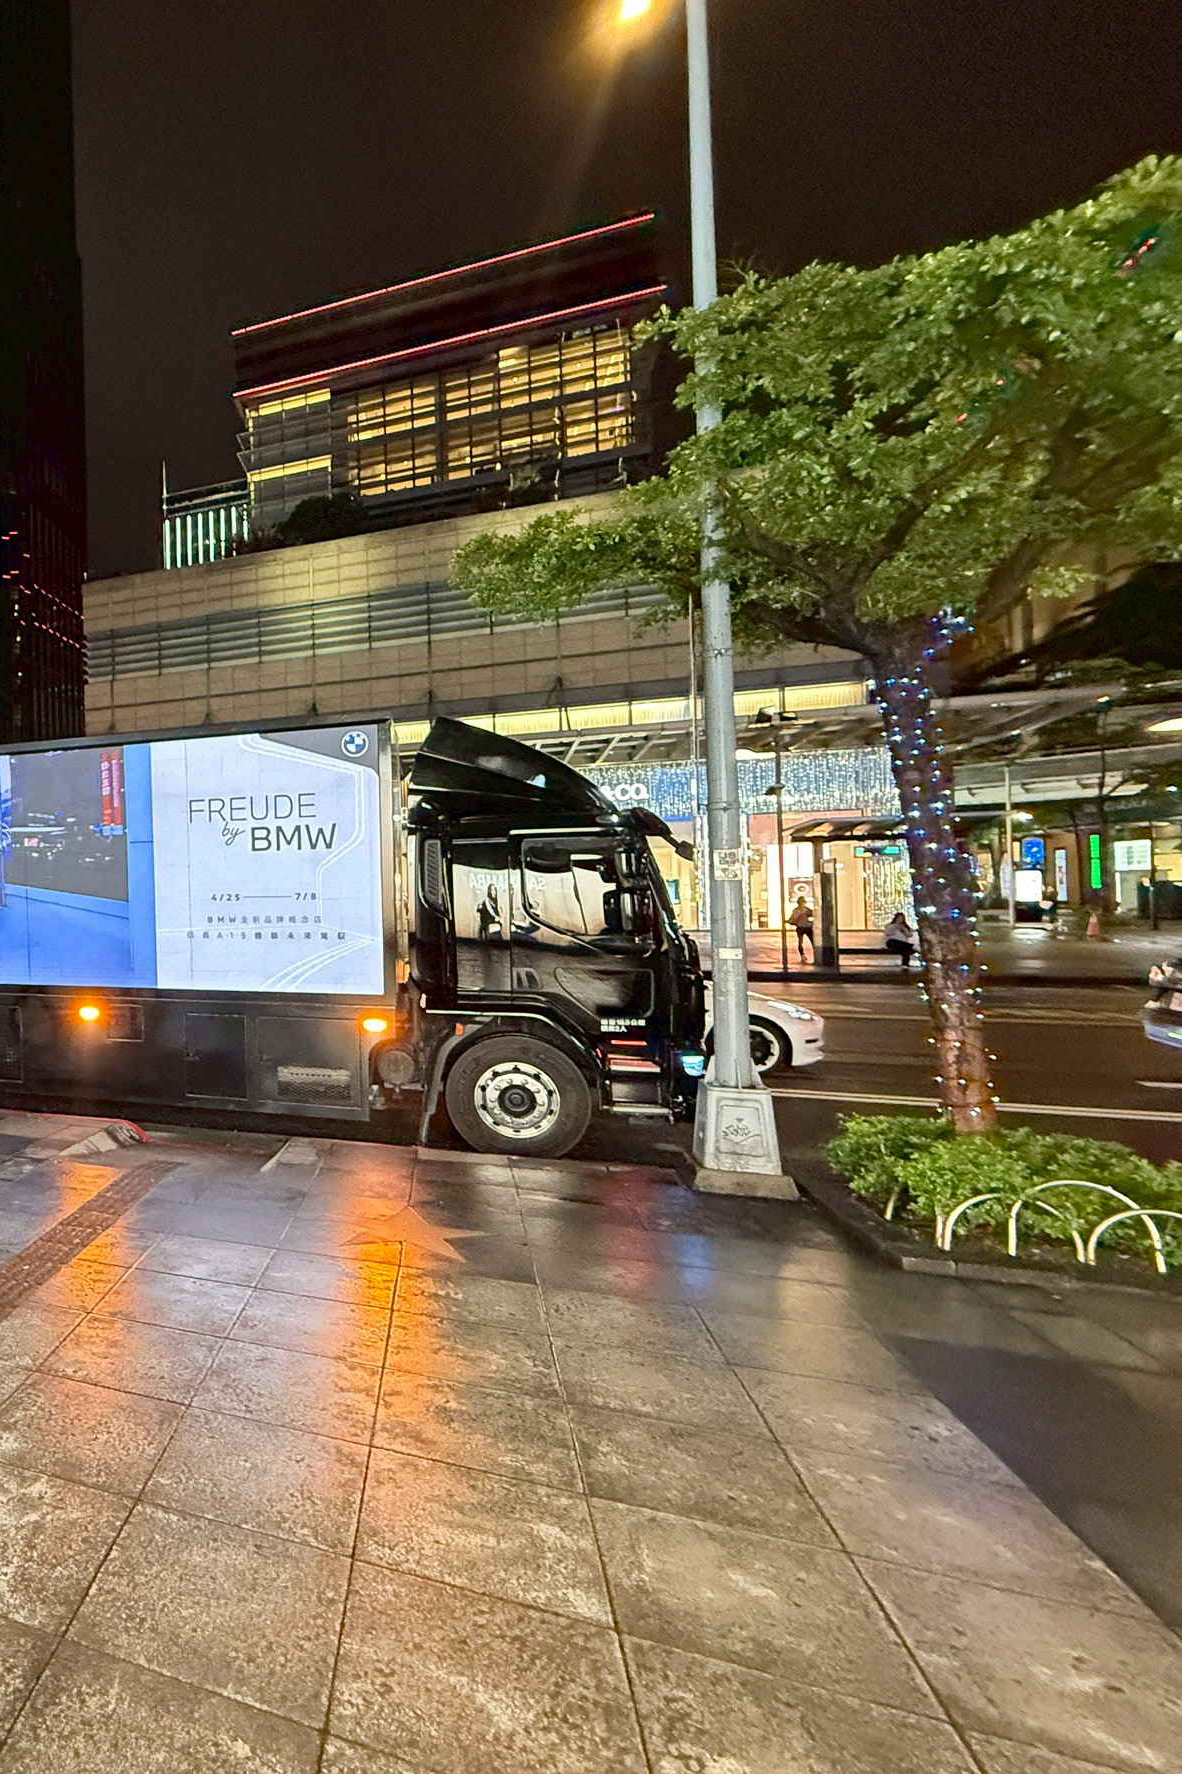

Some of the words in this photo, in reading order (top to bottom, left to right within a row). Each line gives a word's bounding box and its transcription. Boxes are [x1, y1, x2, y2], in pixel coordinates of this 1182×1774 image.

[189, 793, 316, 823] FREUDE
[221, 822, 246, 846] by
[251, 823, 337, 851] BMW
